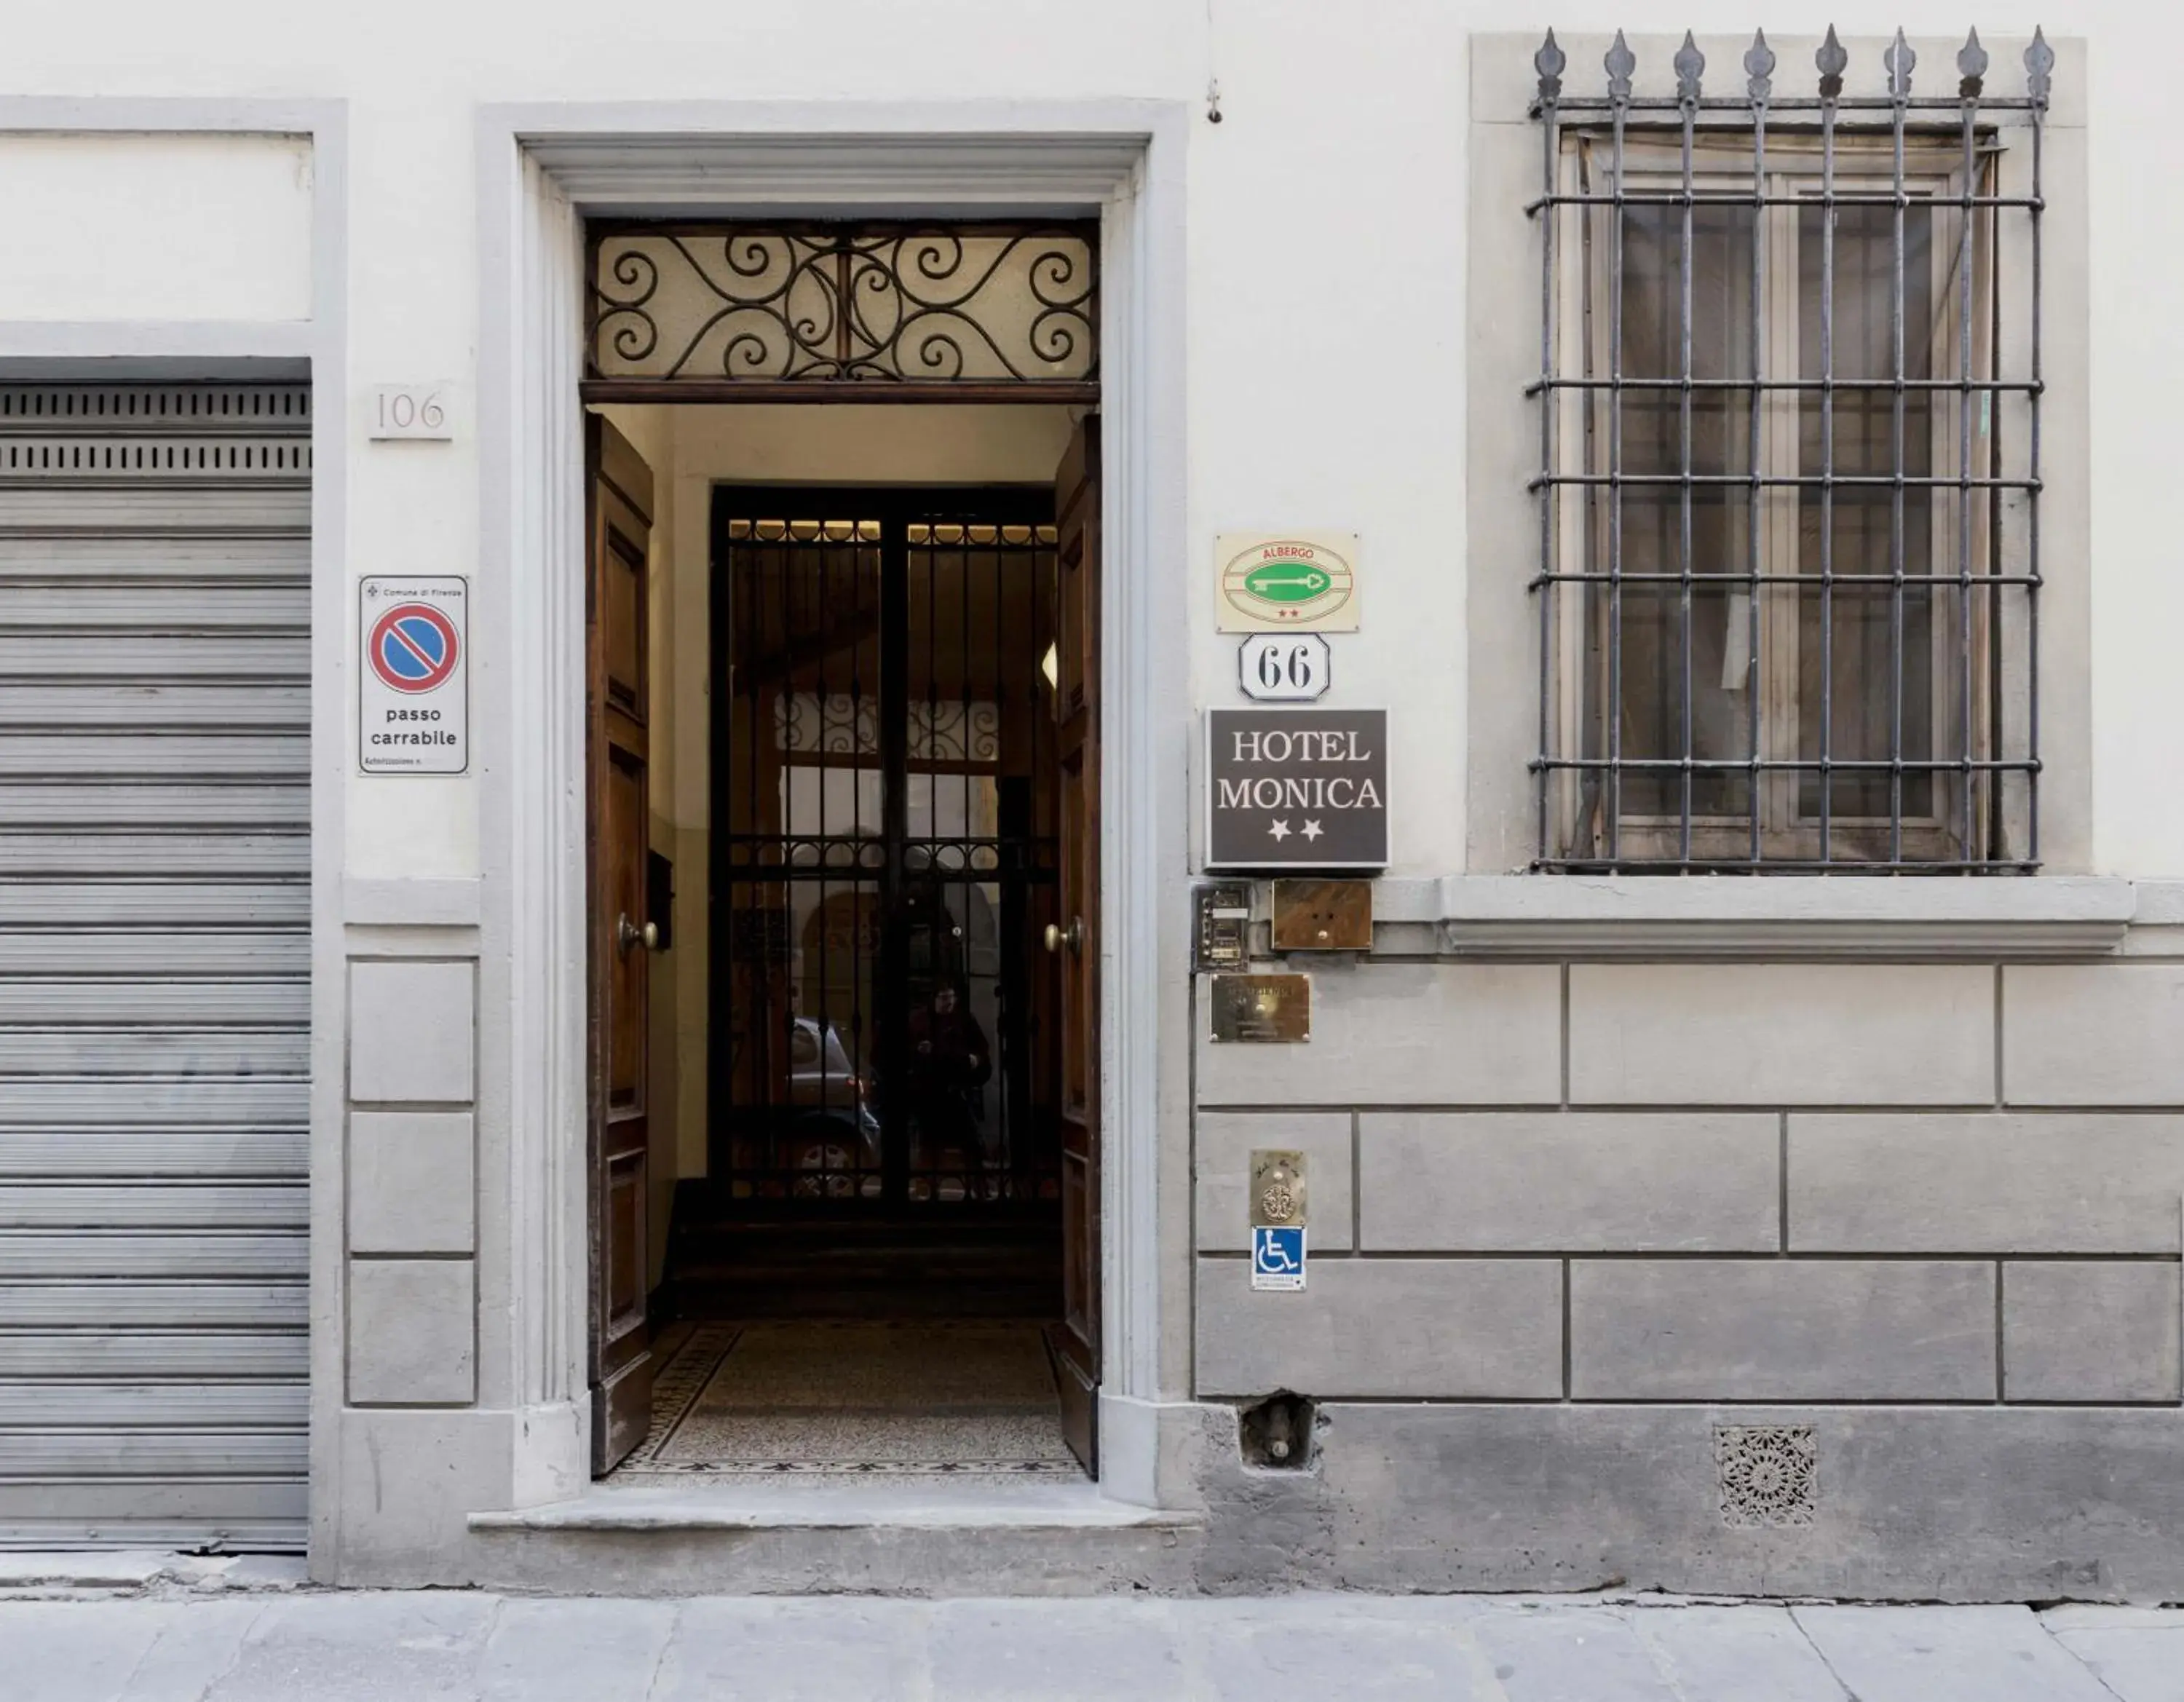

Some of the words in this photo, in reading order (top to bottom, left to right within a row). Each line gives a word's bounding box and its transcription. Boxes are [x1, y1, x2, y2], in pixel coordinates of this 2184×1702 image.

[379, 392, 444, 428] 106
[1262, 547, 1314, 559] ALBERGO
[1258, 644, 1311, 689] 66
[386, 710, 441, 723] passo
[371, 730, 456, 745] carrabile
[1232, 731, 1371, 762] HOTEL
[1217, 778, 1382, 809] MONICA
